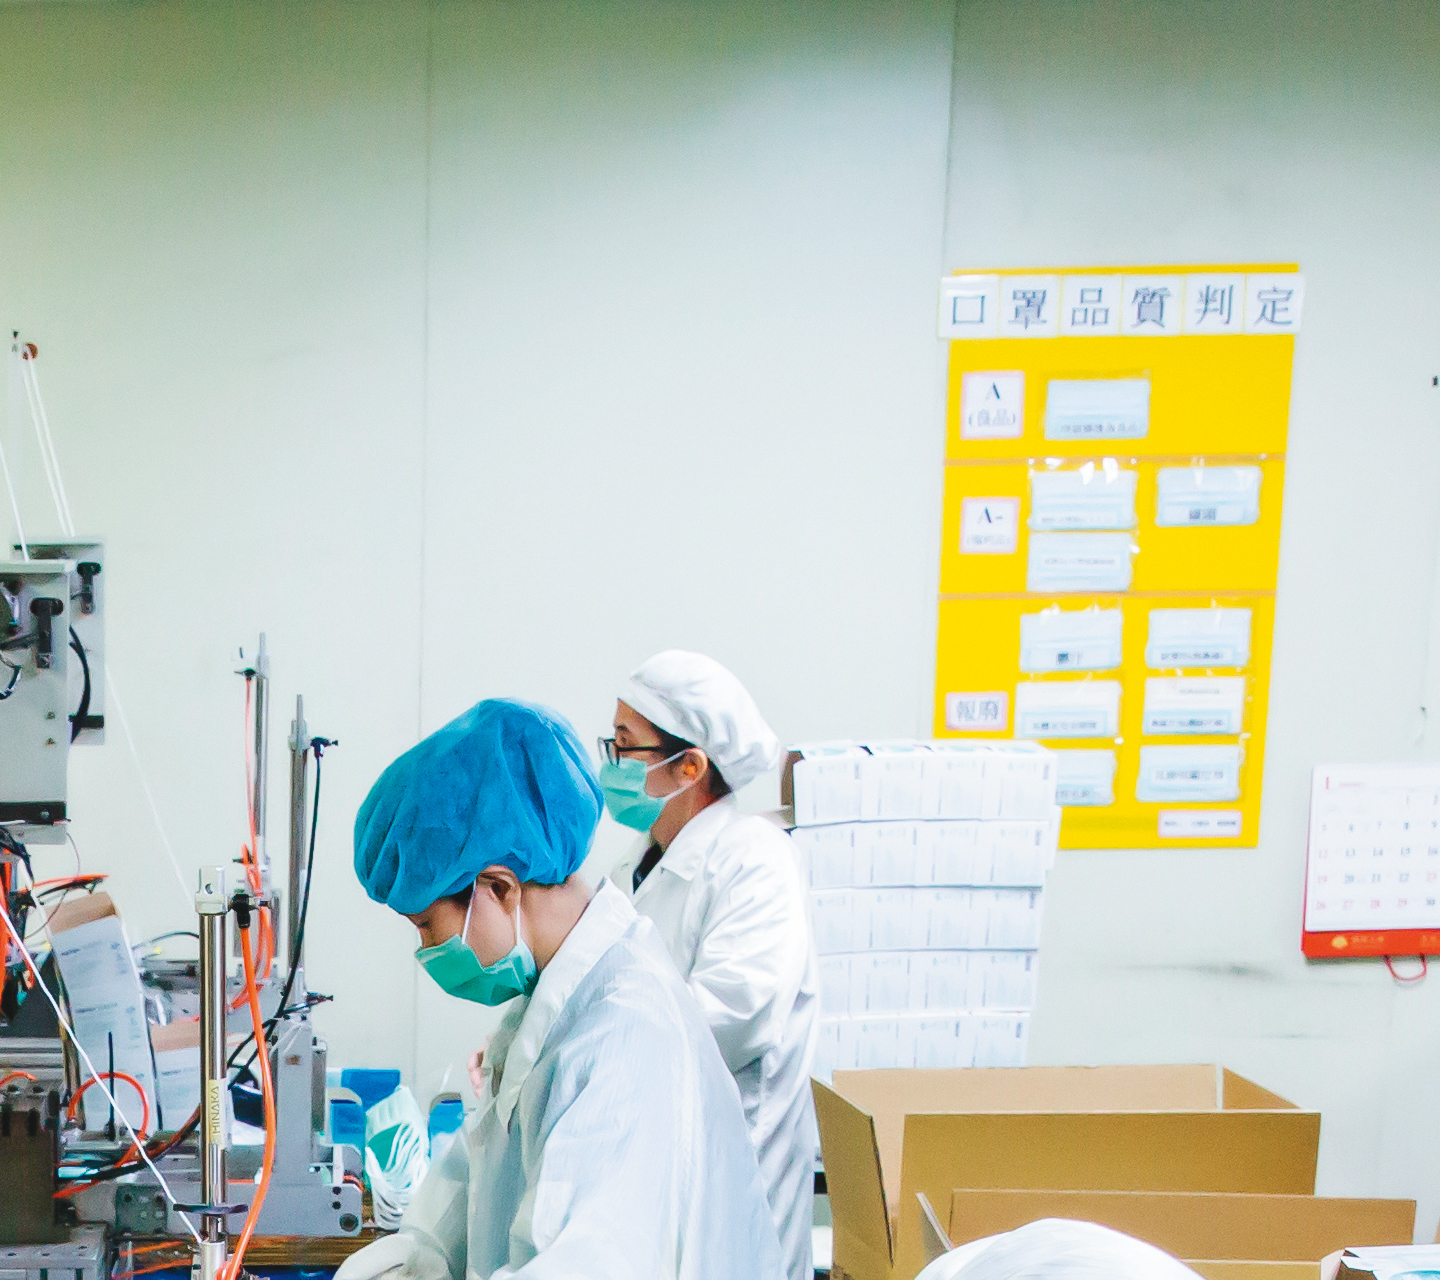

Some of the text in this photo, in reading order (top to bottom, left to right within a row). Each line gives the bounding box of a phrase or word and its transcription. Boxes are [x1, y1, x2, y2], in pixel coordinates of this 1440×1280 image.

[952, 284, 1293, 330] 口罩品質判定
[985, 382, 1001, 400] A
